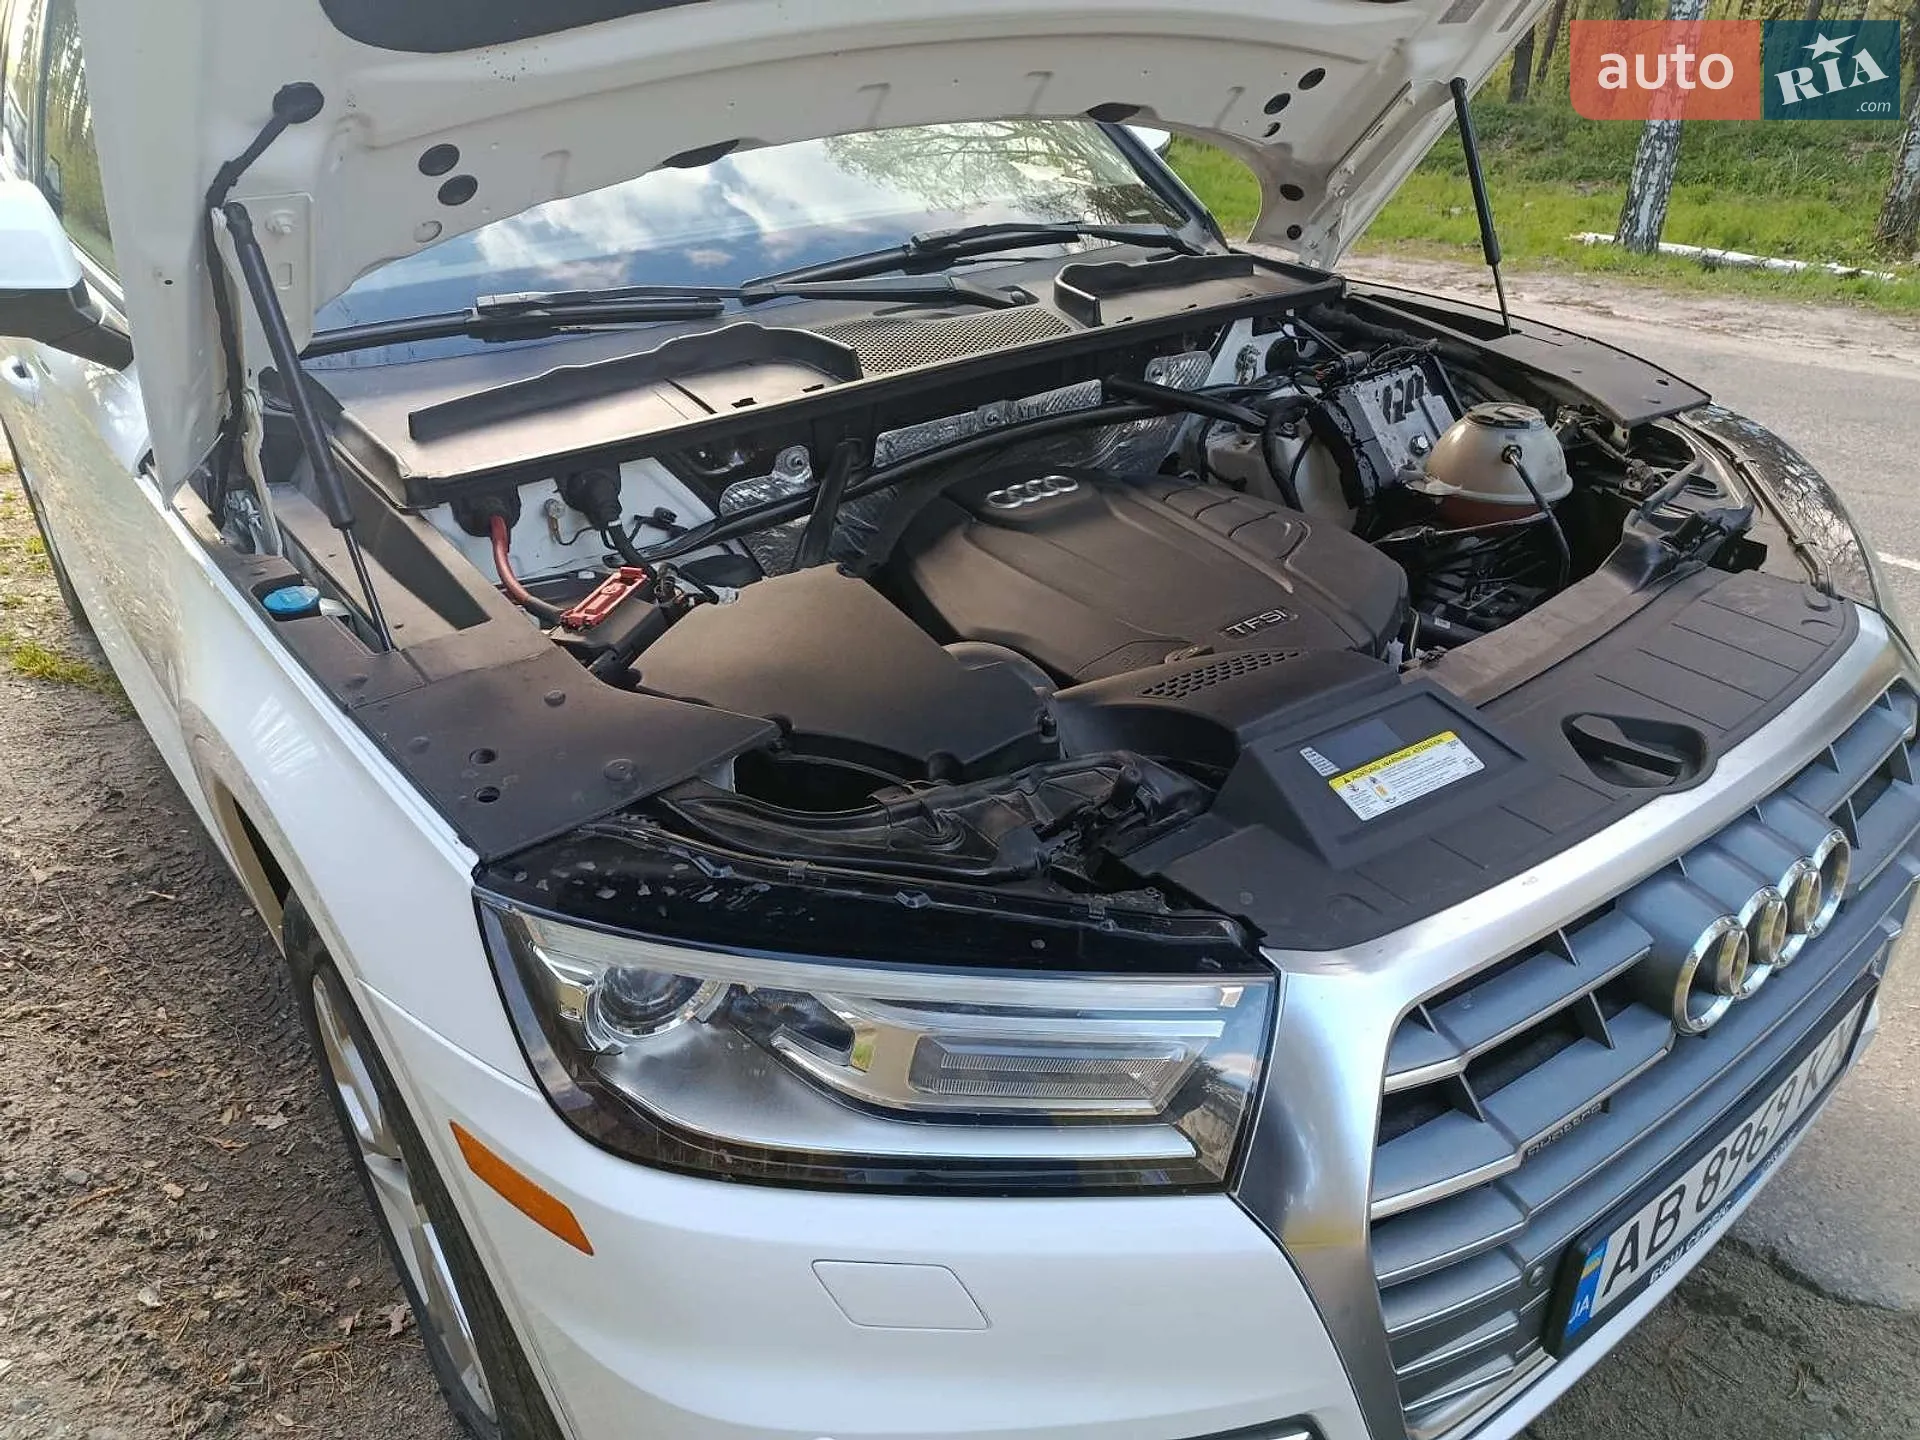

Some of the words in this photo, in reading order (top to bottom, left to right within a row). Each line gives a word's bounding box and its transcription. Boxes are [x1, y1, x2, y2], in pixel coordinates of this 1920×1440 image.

[1225, 607, 1289, 635] TFSI
[1602, 1183, 1687, 1298] AB
[1695, 1075, 1798, 1213] 8969
